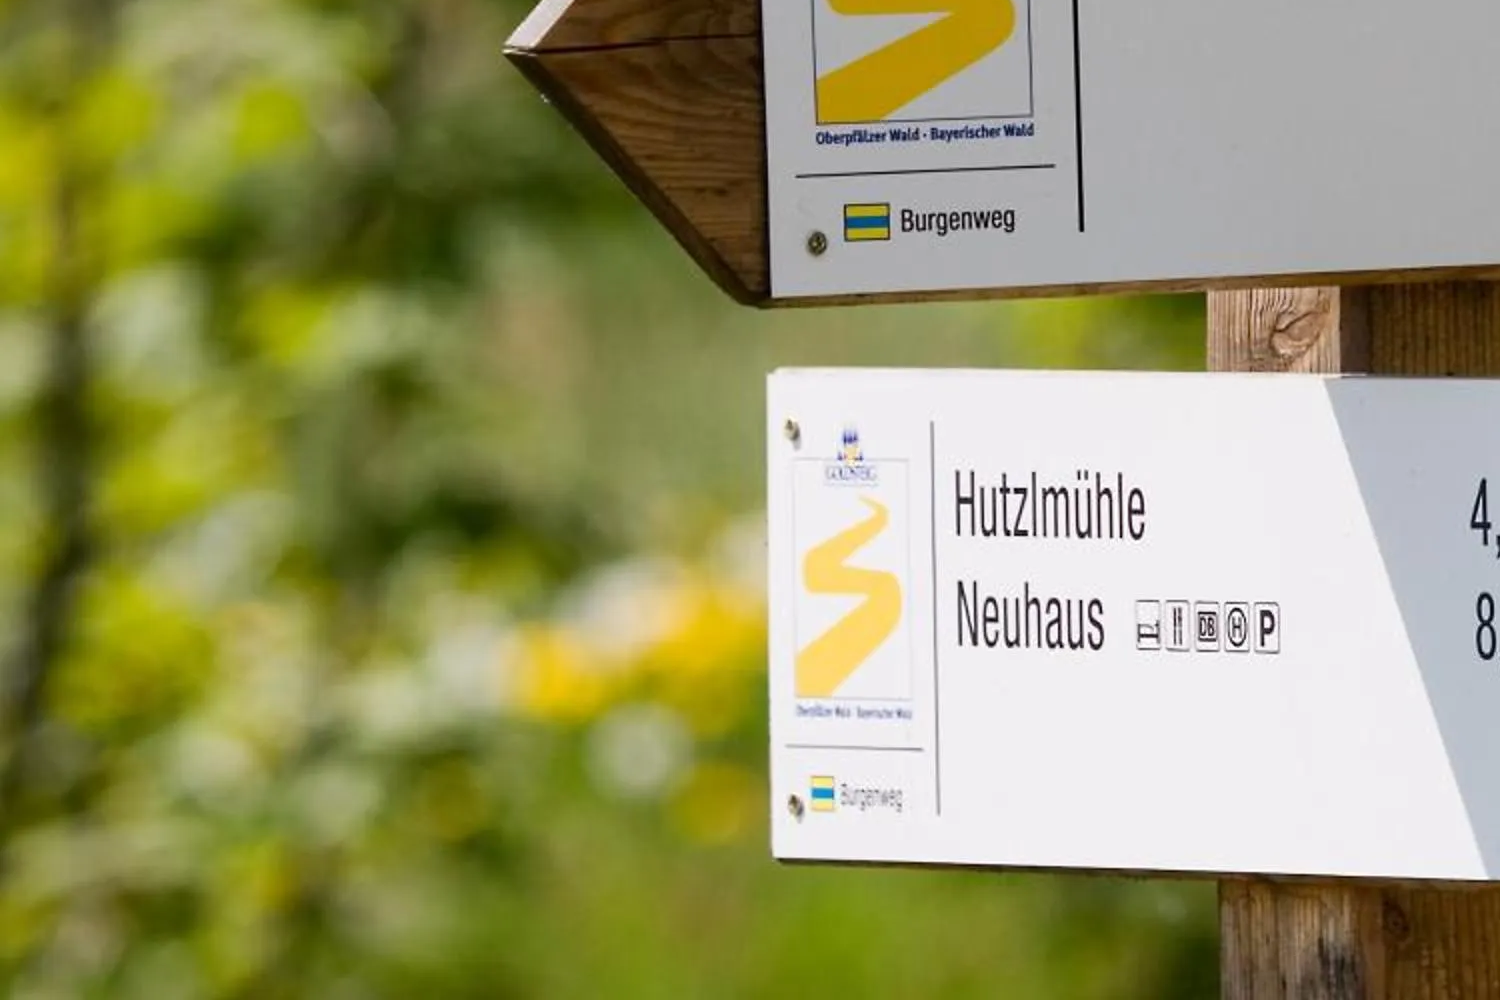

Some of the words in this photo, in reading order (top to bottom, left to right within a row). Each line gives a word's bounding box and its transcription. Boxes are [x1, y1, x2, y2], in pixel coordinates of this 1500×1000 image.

[815, 129, 887, 147] Oberpfälzer
[889, 127, 921, 142] Wald
[930, 126, 1001, 143] Bayerischer
[1003, 122, 1035, 138] Wald
[901, 209, 1016, 237] Burgenweg
[954, 469, 1146, 541] Hutzlmühle
[957, 580, 1105, 651] Neuhaus
[1259, 609, 1276, 647] P
